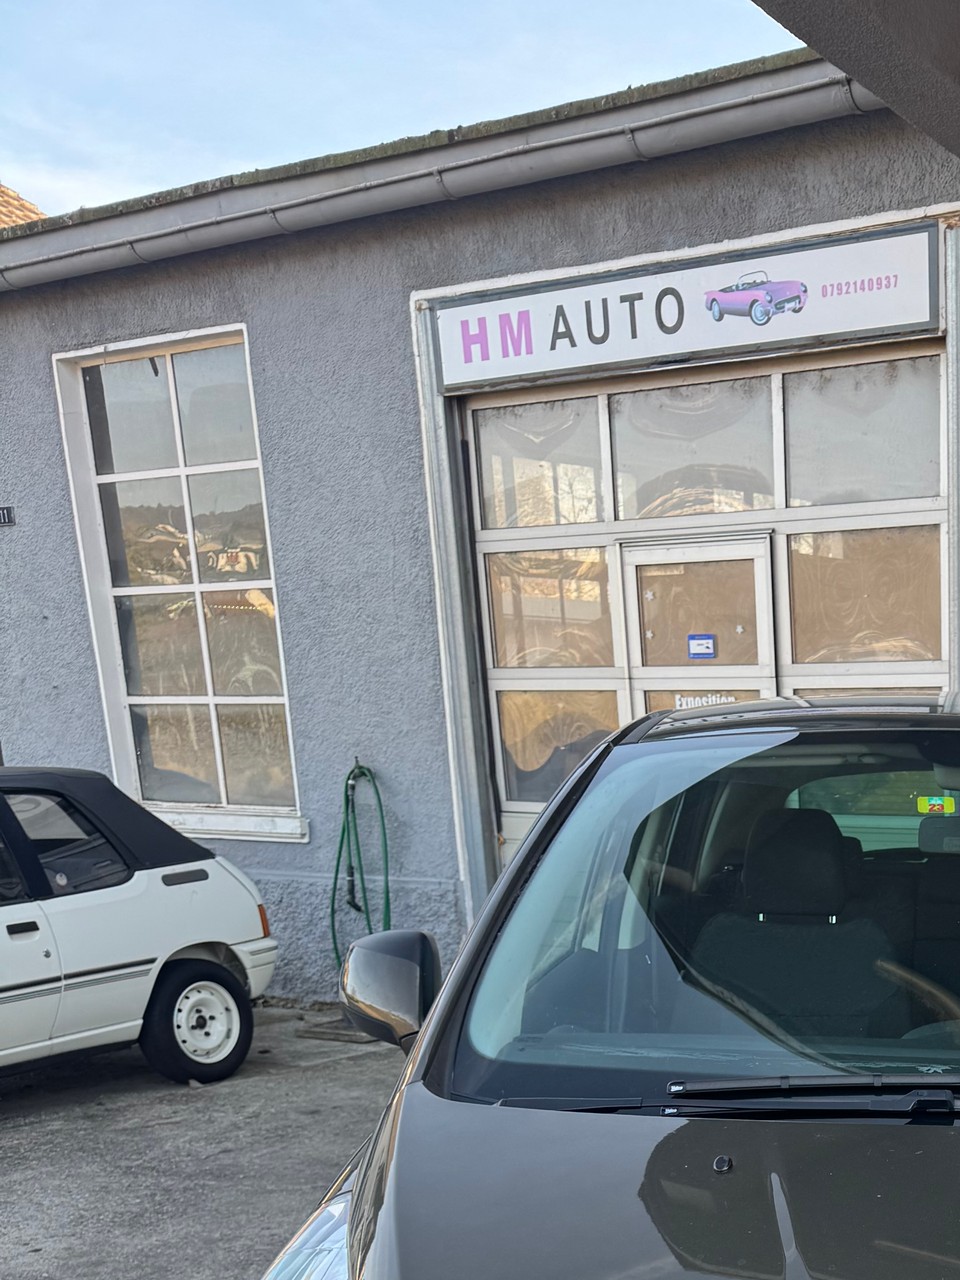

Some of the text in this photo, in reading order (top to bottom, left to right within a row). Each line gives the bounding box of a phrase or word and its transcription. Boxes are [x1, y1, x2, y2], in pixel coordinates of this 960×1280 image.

[460, 274, 898, 364] HM AUTO 0792140937
[928, 803, 945, 813] 23
